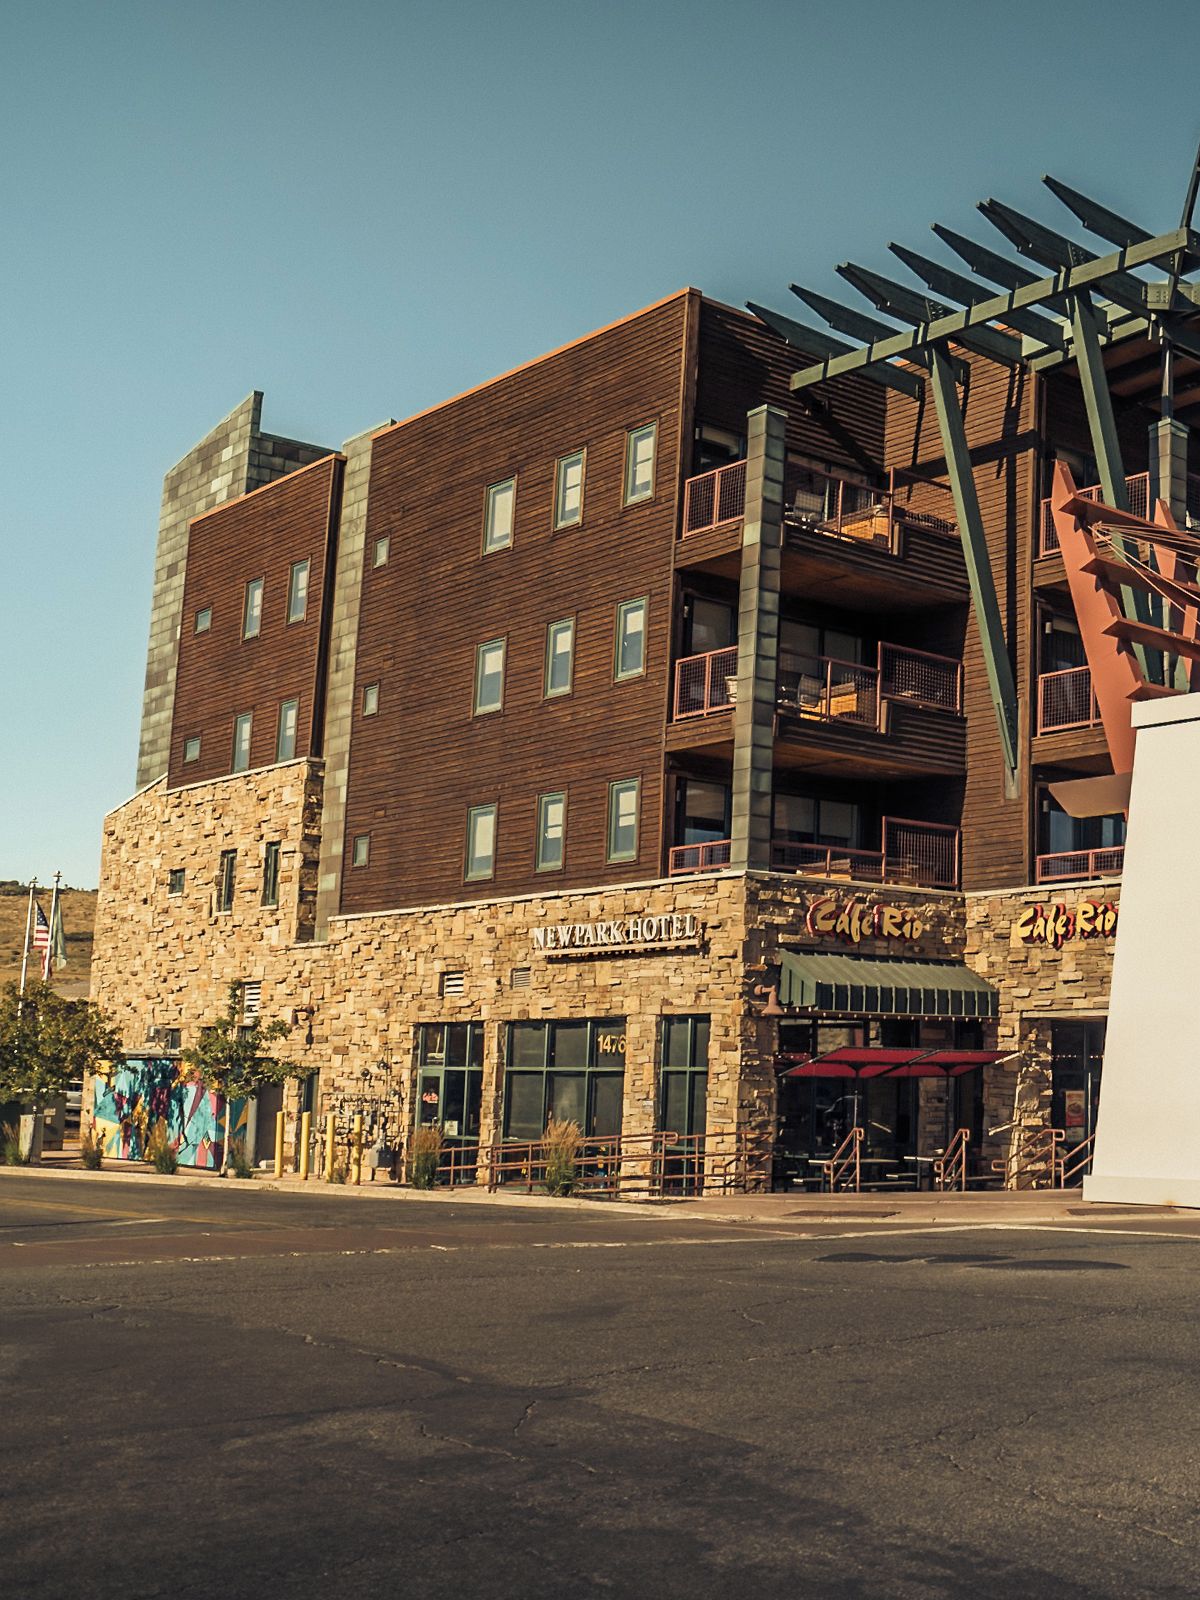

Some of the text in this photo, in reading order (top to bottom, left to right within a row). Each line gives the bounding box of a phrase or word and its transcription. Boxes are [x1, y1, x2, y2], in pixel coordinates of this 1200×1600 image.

[531, 913, 697, 949] NEWPARK HOTEL
[811, 900, 923, 943] Cafe Rio
[1016, 901, 1117, 944] Cafe Rio
[597, 1034, 626, 1054] 1476
